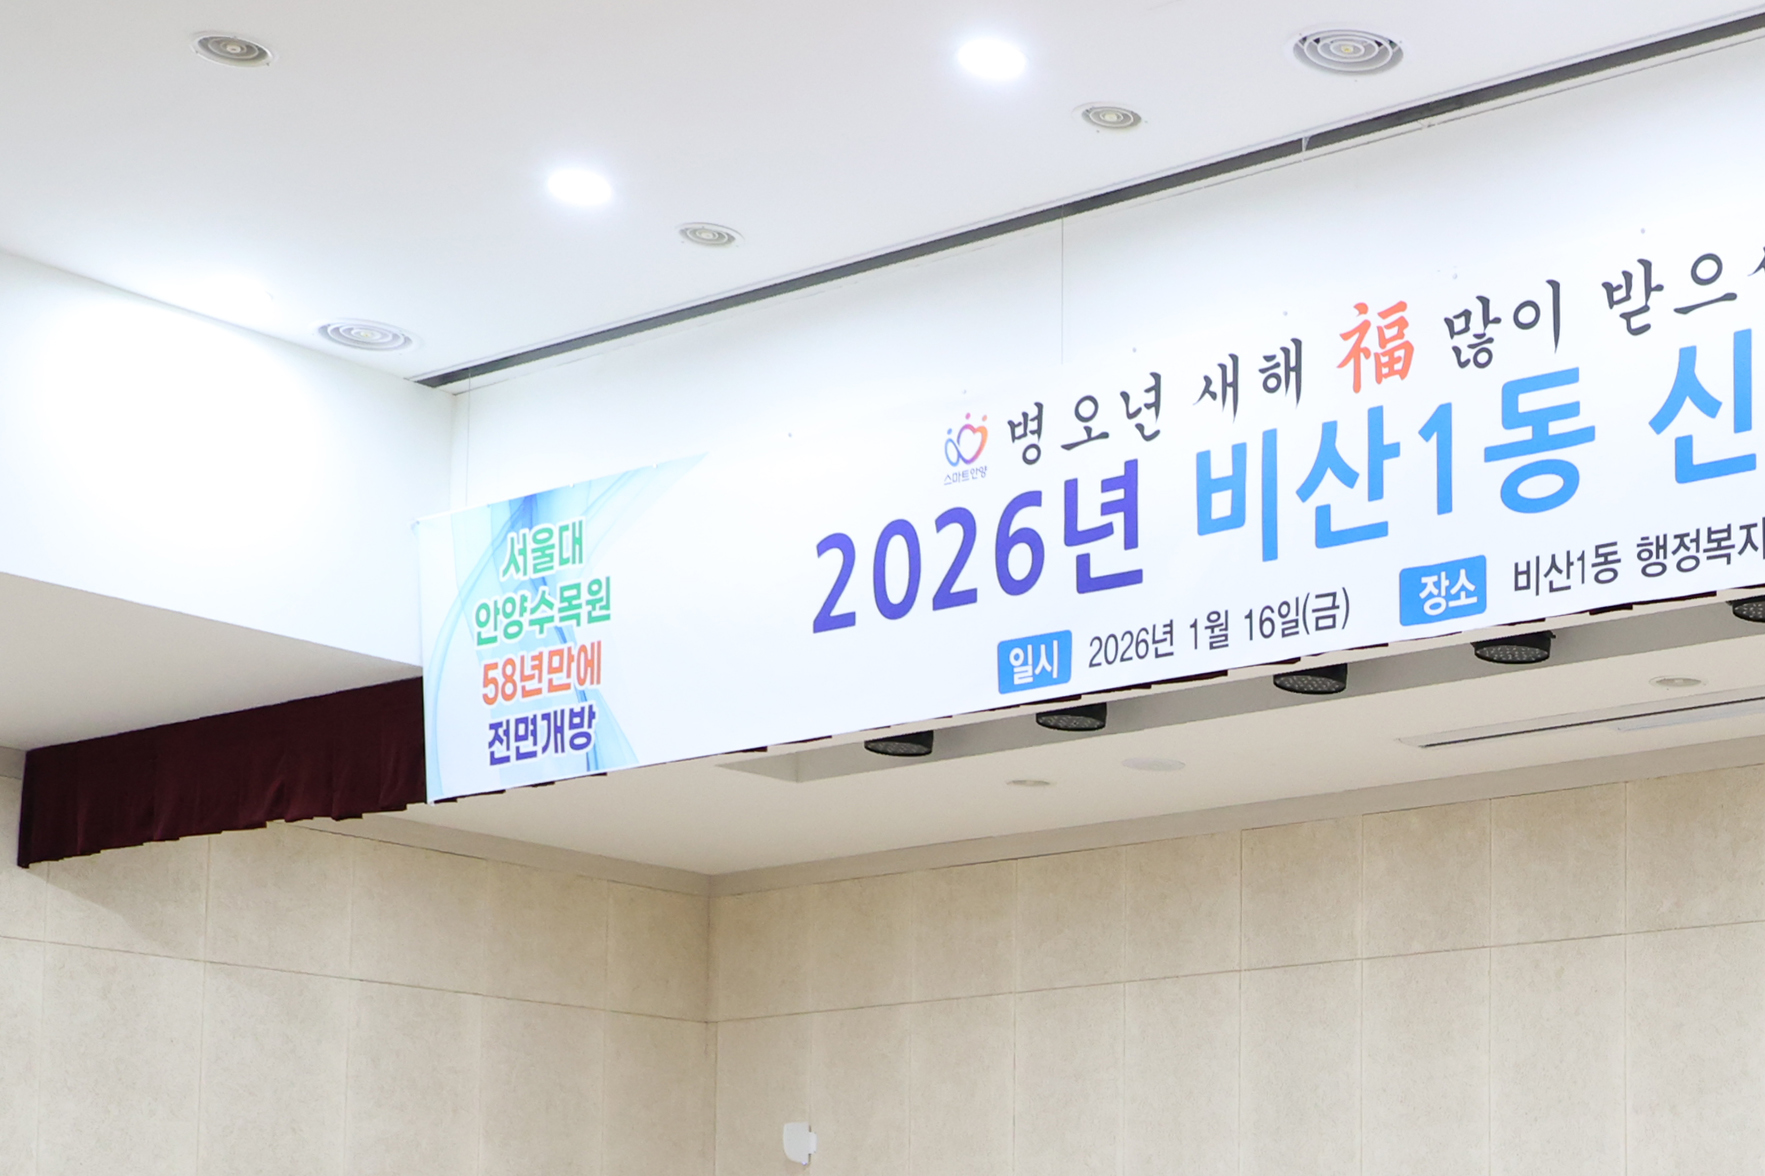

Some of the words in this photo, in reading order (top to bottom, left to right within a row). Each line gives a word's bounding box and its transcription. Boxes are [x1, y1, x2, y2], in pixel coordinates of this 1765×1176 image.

[1337, 300, 1415, 393] 福
[1444, 279, 1561, 369] 많이
[812, 459, 1143, 634] 2026년
[1195, 367, 1596, 562] 비산1동
[944, 467, 988, 486] 스마트안양
[502, 519, 584, 579] 서울대
[1513, 541, 1622, 597] 비산1동
[475, 576, 612, 646] 안양수목원
[1418, 567, 1478, 616] 장소
[1088, 623, 1175, 669] 2026년
[1189, 610, 1231, 651] 1월
[1243, 587, 1350, 642] 16일(금)
[482, 640, 602, 706] 58년만에
[1008, 645, 1060, 684] 일시
[488, 705, 596, 766] 전면개방
